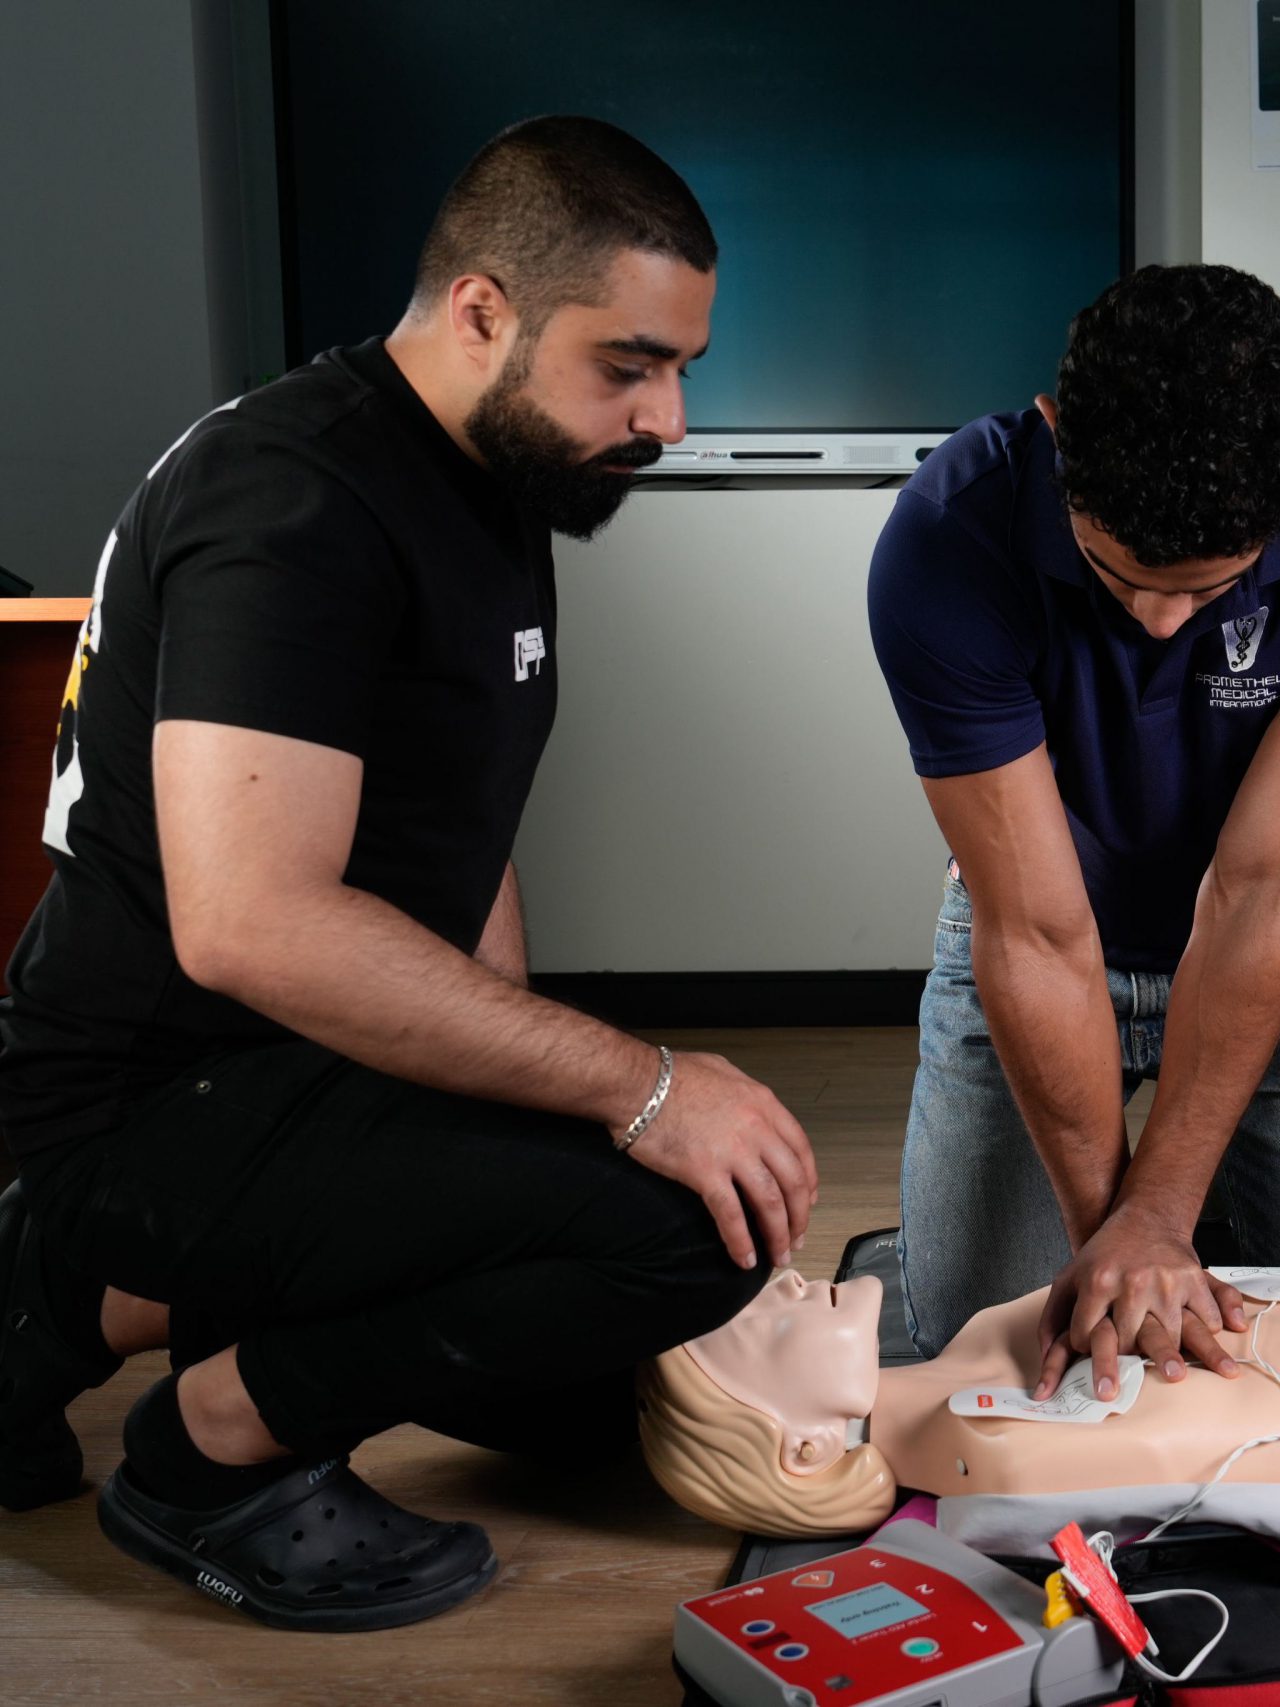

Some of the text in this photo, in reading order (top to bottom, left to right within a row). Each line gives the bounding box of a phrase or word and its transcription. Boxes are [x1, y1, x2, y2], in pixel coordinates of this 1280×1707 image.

[1211, 687, 1277, 699] MEDICAL
[869, 1559, 887, 1569] 3
[197, 1571, 244, 1604] LUOFU
[915, 1583, 935, 1595] 2
[972, 1621, 988, 1632] 1
